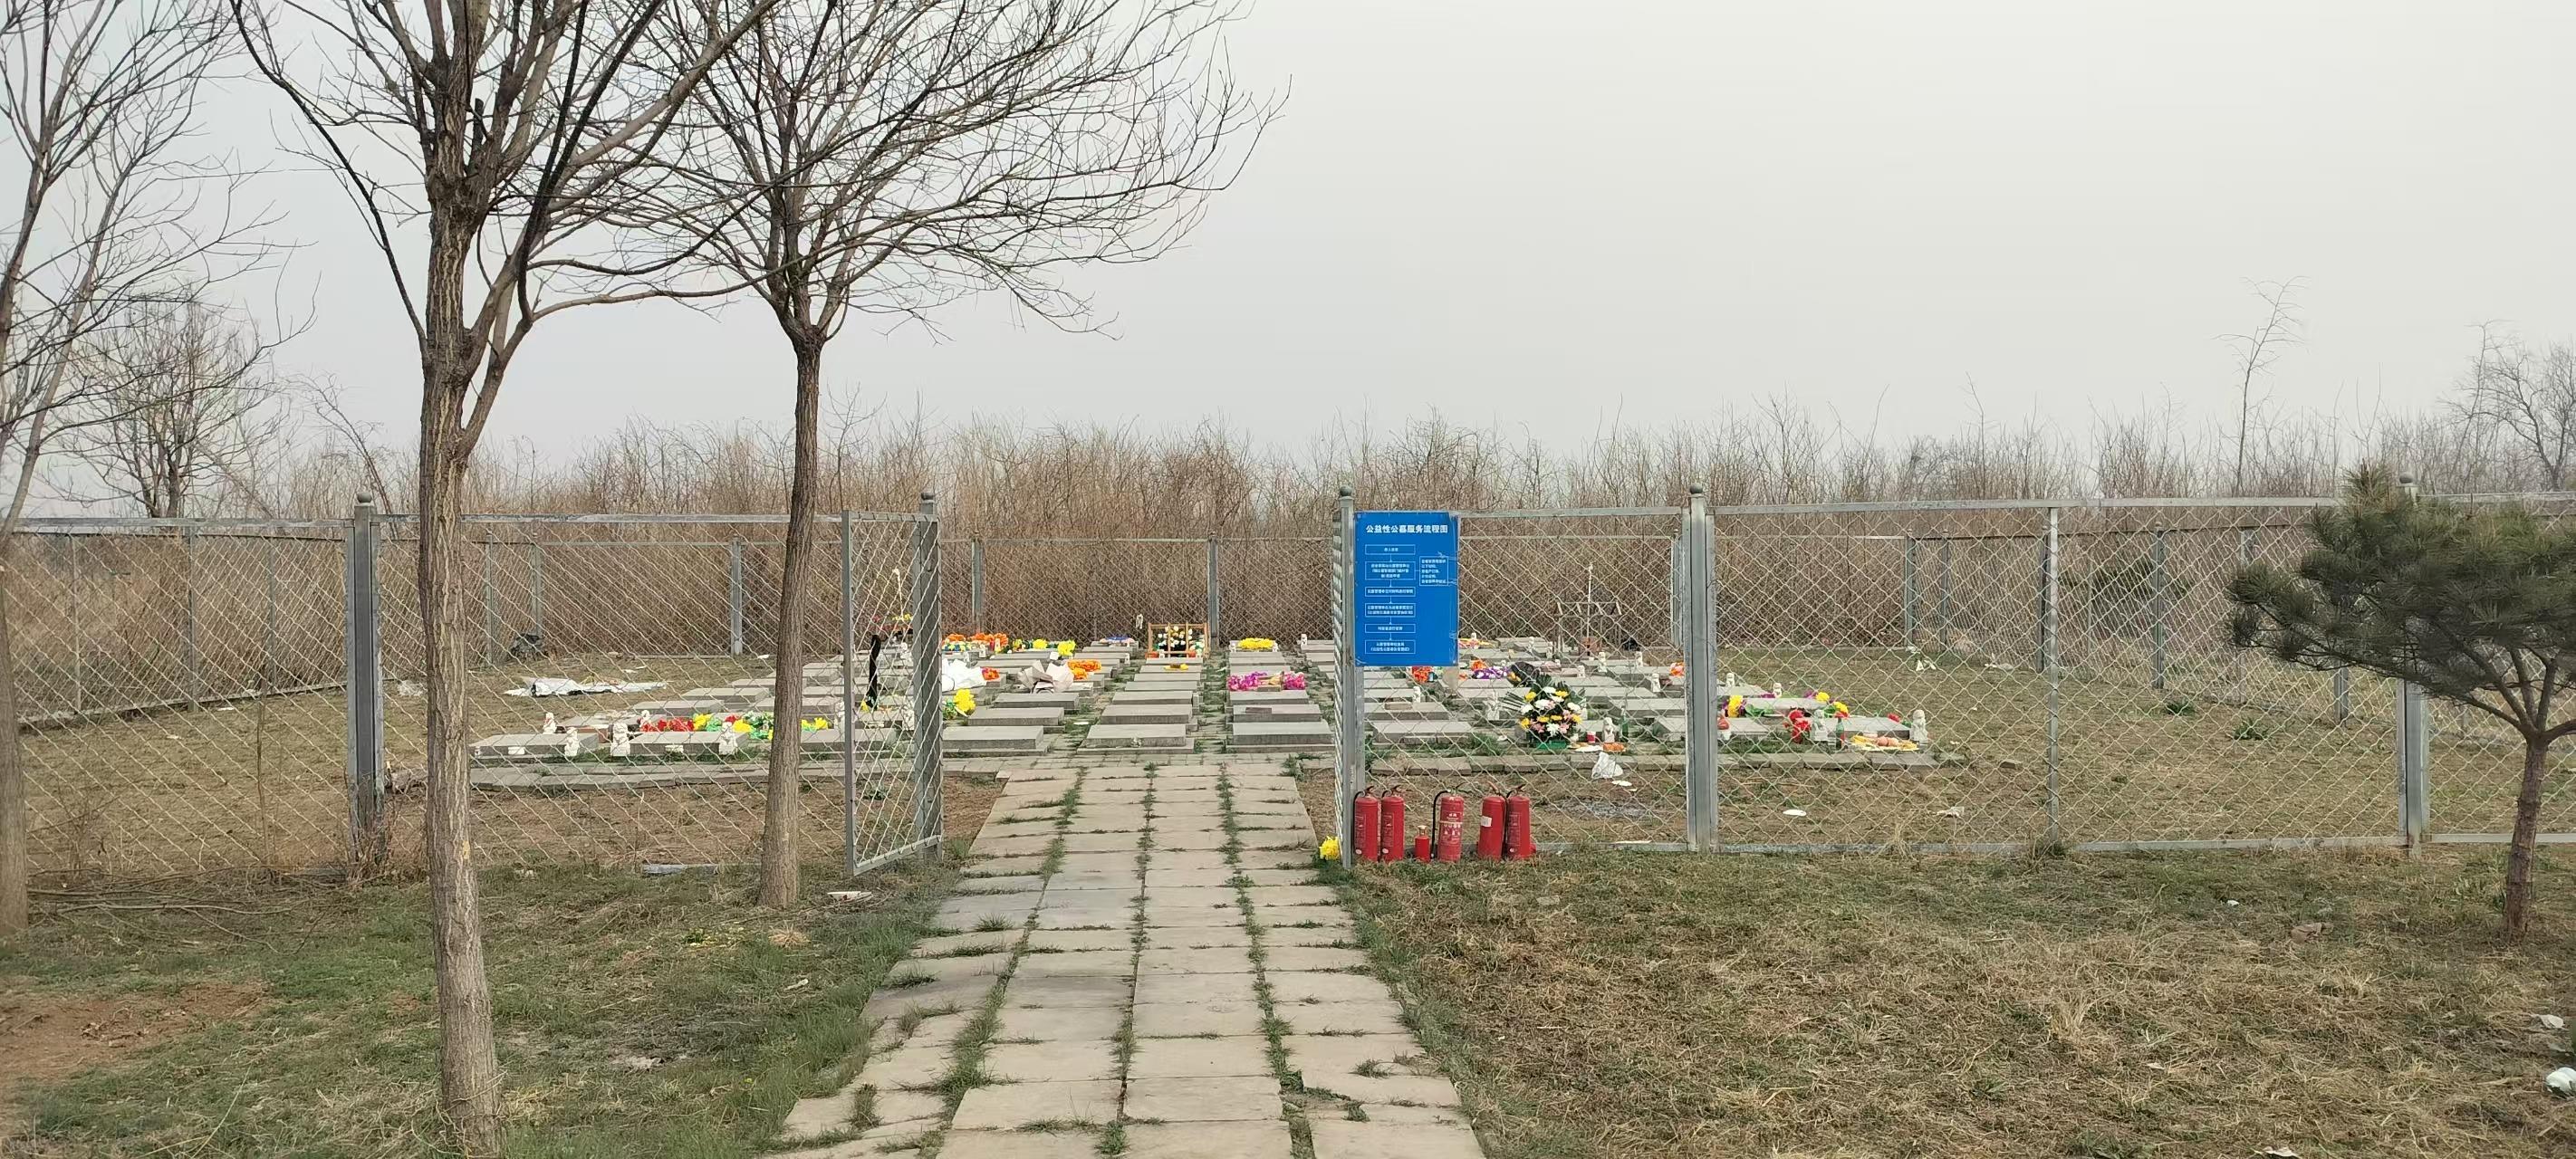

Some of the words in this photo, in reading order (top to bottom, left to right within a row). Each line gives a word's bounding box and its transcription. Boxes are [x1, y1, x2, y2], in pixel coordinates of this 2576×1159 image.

[1366, 524, 1448, 533] 公益性公墓服务流程图
